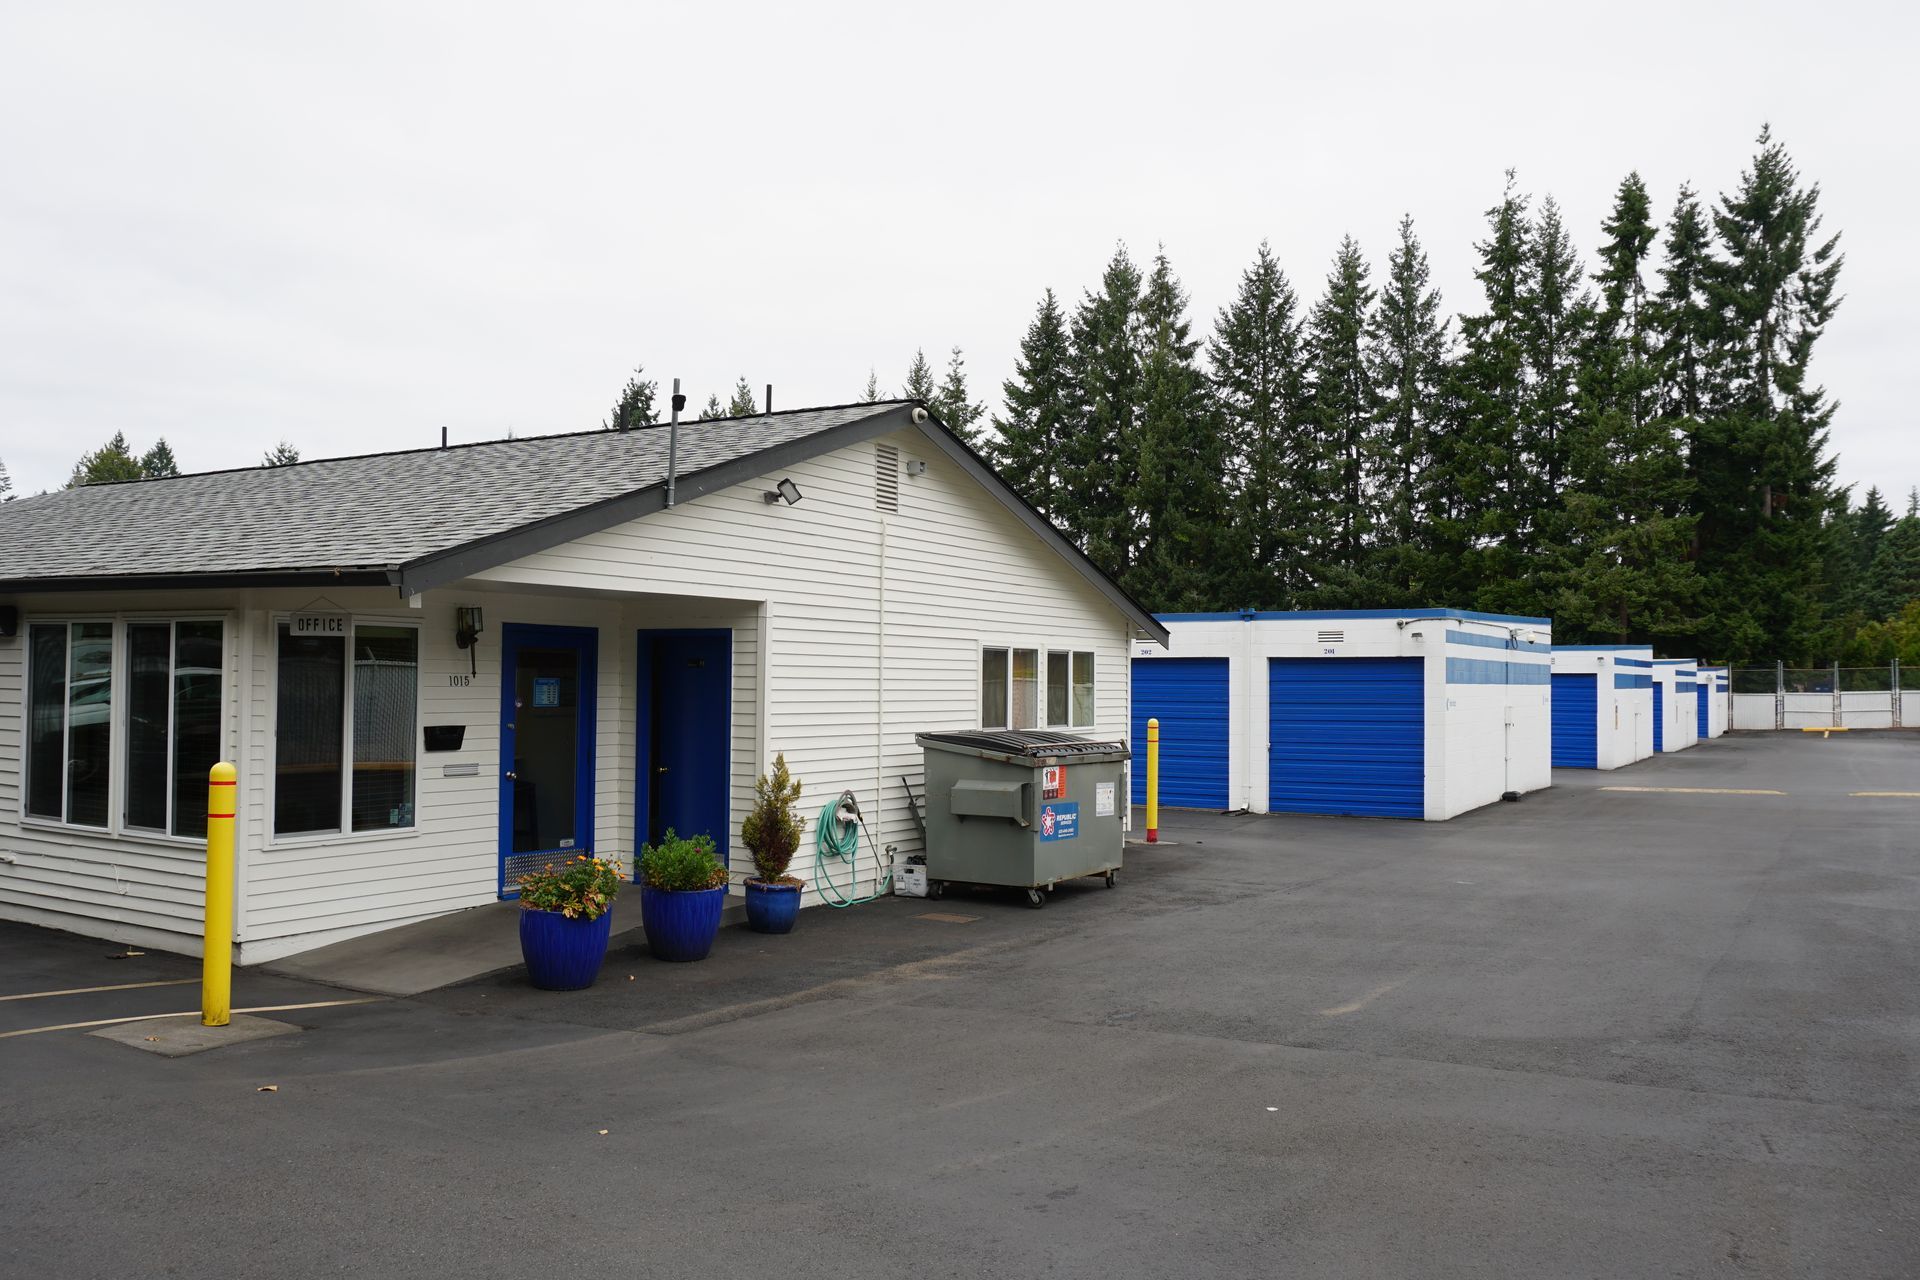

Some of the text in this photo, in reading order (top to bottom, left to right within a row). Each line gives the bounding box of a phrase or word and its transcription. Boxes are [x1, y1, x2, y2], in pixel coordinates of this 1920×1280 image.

[298, 618, 342, 631] OFFICE
[449, 675, 469, 686] 1015
[1056, 813, 1077, 821] REPUBLIC
